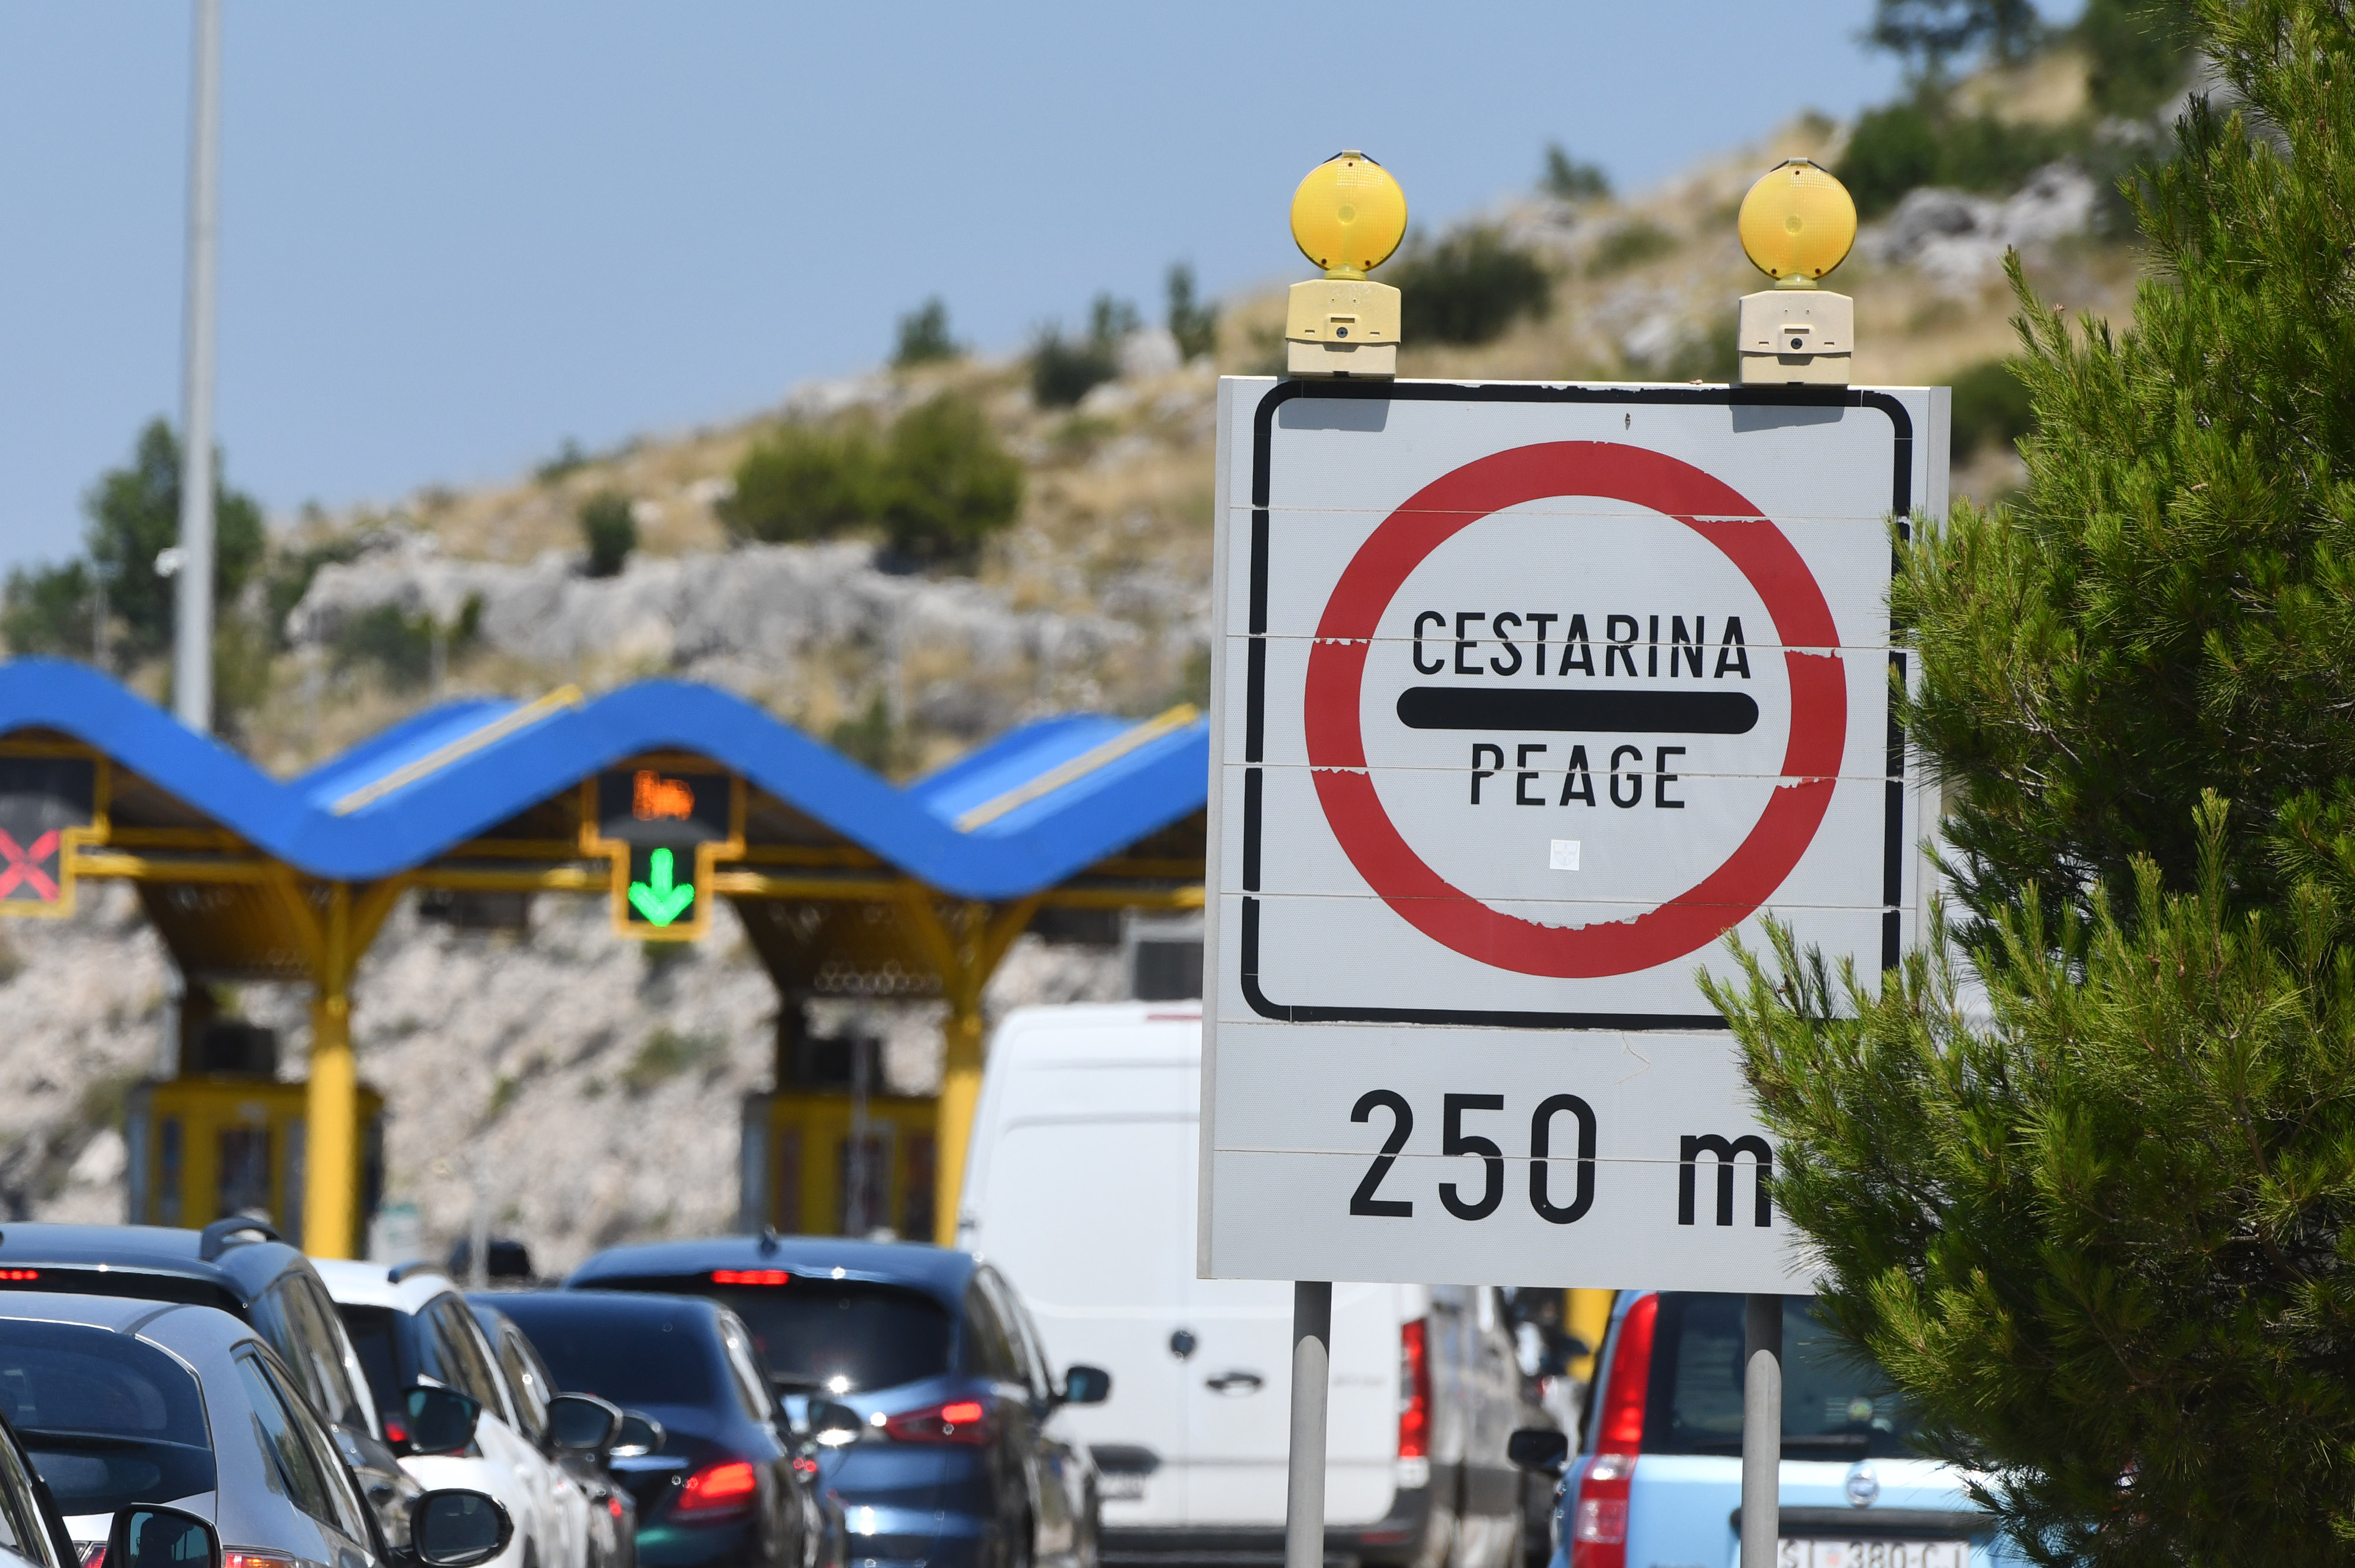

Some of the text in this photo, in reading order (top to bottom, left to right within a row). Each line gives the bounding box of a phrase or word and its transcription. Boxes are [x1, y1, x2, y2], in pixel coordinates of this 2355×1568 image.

[1413, 610, 1751, 679] CESTARINA
[1471, 743, 1686, 809] PEAGE
[1349, 1089, 1773, 1227] 250 m
